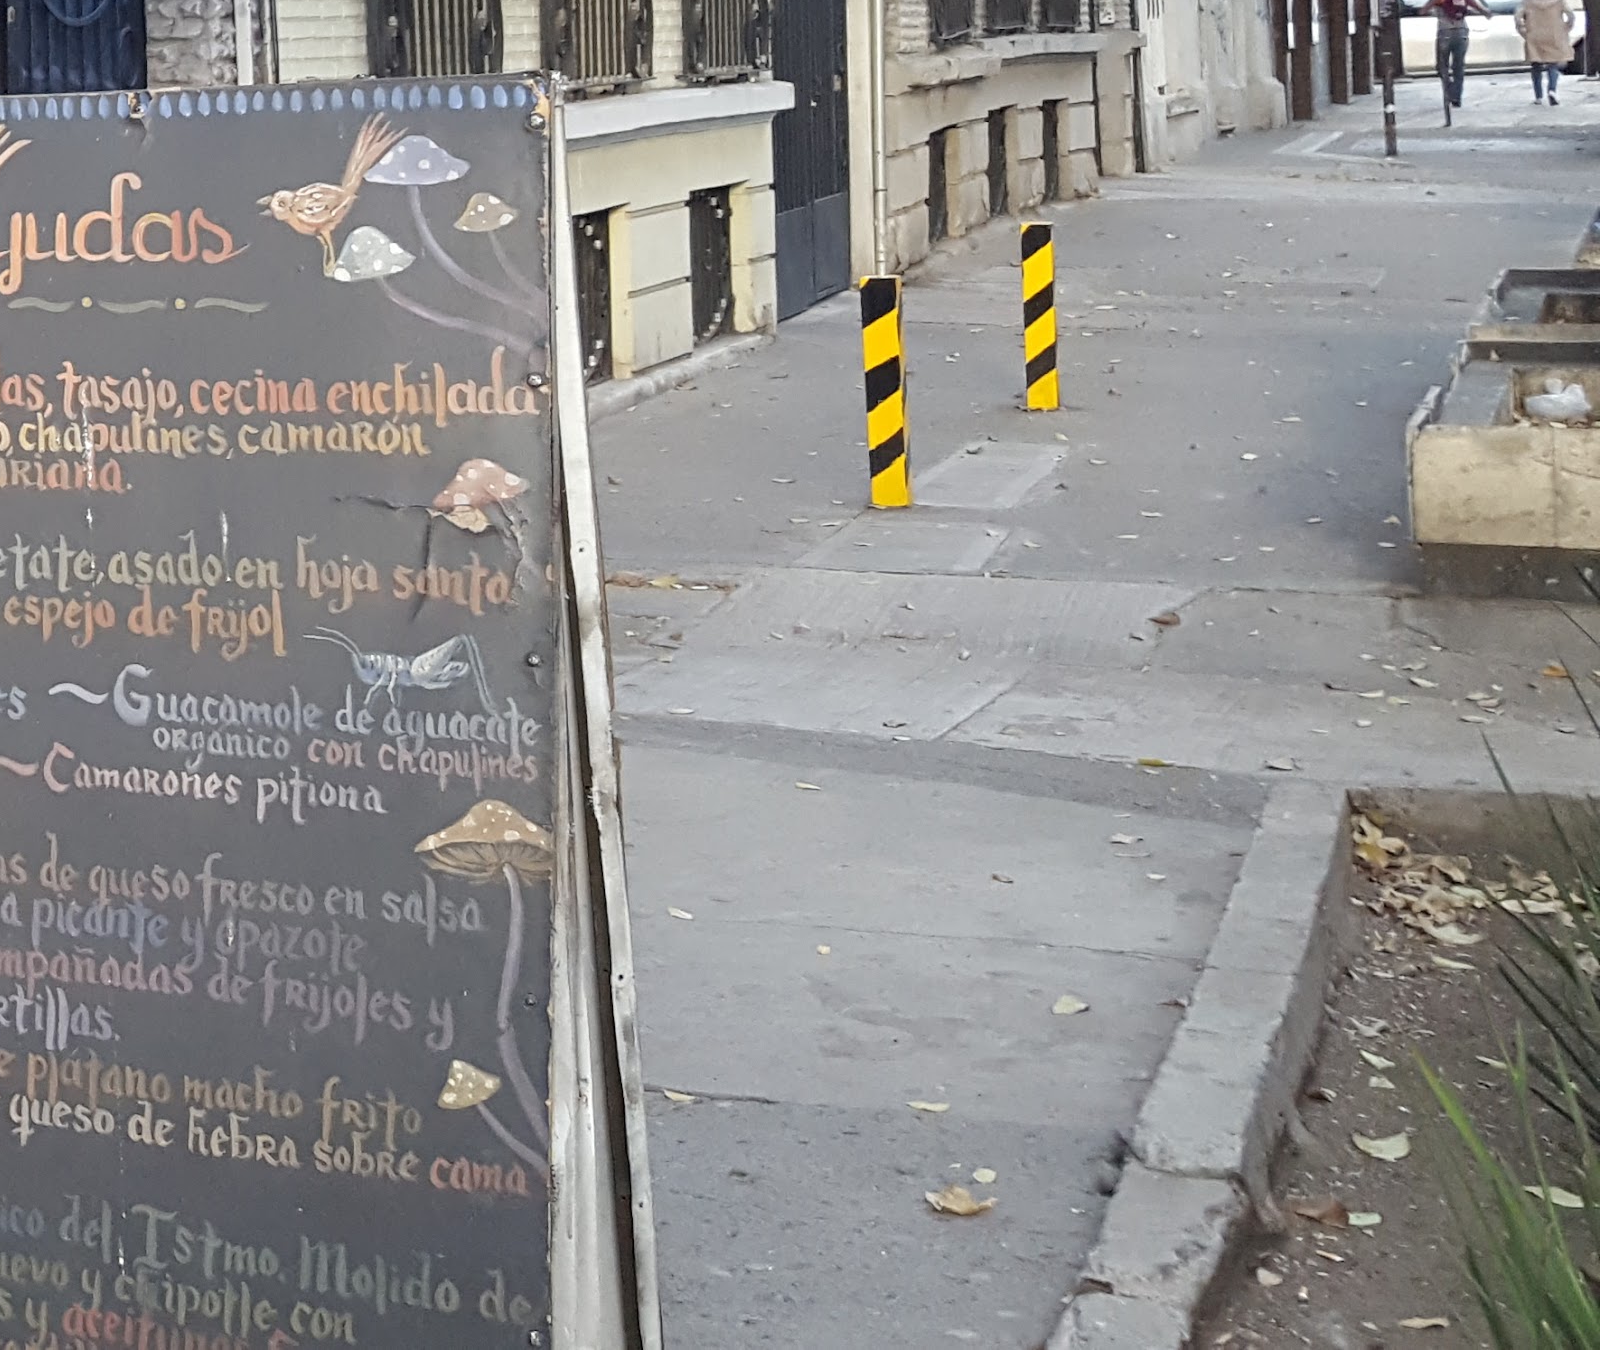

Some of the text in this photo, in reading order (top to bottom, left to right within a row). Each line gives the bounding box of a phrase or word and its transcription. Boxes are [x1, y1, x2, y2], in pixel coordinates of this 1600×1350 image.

[56, 361, 183, 428] tasajo,
[189, 369, 318, 414] cecina
[326, 345, 540, 428] enchilada
[108, 530, 222, 587] asado
[235, 555, 283, 590] en
[297, 535, 381, 613] hoja
[4, 591, 116, 648] espejo
[128, 582, 178, 636] de
[183, 589, 286, 662] frijol
[114, 663, 322, 732] Guacamole
[335, 684, 375, 734] de
[382, 698, 543, 762] aguacate
[43, 742, 388, 826] Camarones pitiona
[307, 738, 365, 770] con
[378, 737, 539, 796] chapulines
[40, 832, 80, 892] de
[89, 863, 190, 912] queso
[200, 852, 311, 926] fresco
[324, 885, 366, 920] en
[381, 874, 484, 946] salsa
[31, 897, 169, 948] picante
[182, 917, 203, 972] y
[208, 951, 253, 1004] de
[259, 959, 412, 1046] frijoles
[428, 995, 454, 1050] y
[10, 1094, 114, 1145] queso
[128, 1102, 174, 1148] de
[188, 1109, 299, 1169] hebra
[314, 1133, 418, 1182] sobre
[430, 1156, 530, 1196] cama
[184, 1064, 303, 1118] macho
[316, 1076, 422, 1150] frito
[60, 1195, 112, 1264] del
[300, 1234, 460, 1314] Molido
[480, 1270, 535, 1324] de
[26, 1298, 47, 1350] y
[82, 1268, 101, 1310] y
[115, 1262, 277, 1337] chipotle
[290, 1300, 357, 1345] con
